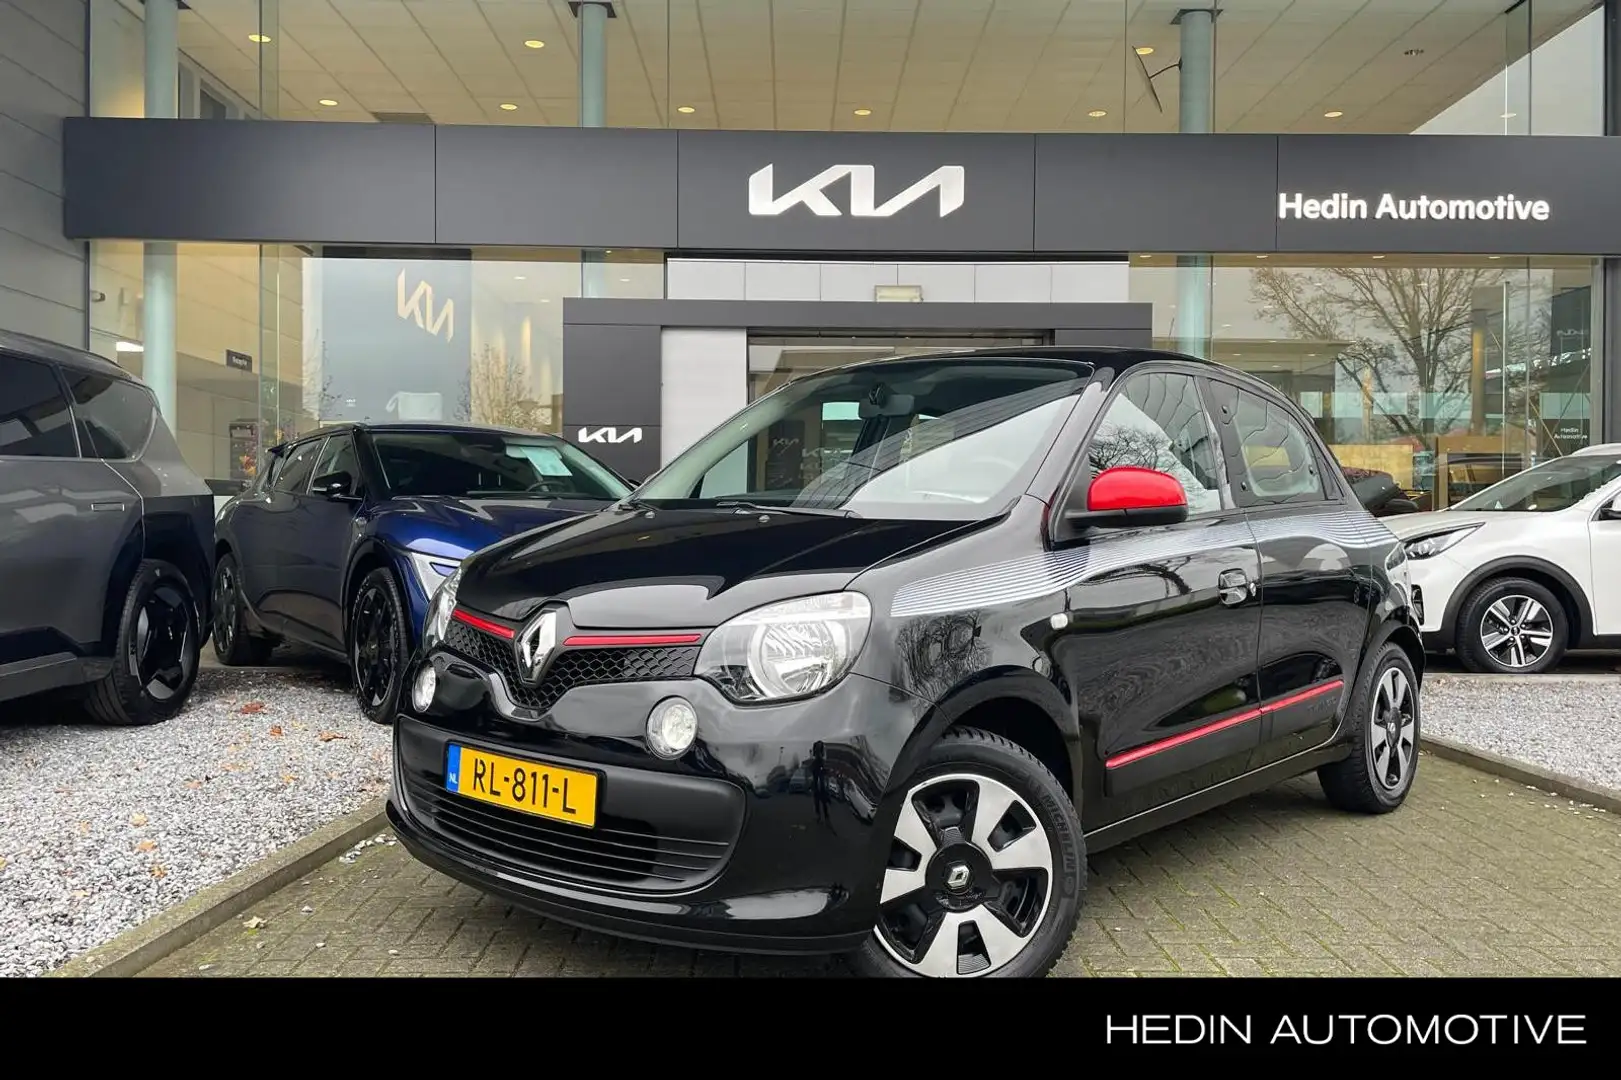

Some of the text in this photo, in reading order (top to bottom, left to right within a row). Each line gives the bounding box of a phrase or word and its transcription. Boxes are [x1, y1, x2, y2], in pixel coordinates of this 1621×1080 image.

[749, 163, 965, 217] KIA
[1278, 192, 1550, 220] Hedin Automotive
[578, 426, 643, 443] KIA
[448, 772, 458, 784] NL
[472, 757, 577, 815] RL-811-L
